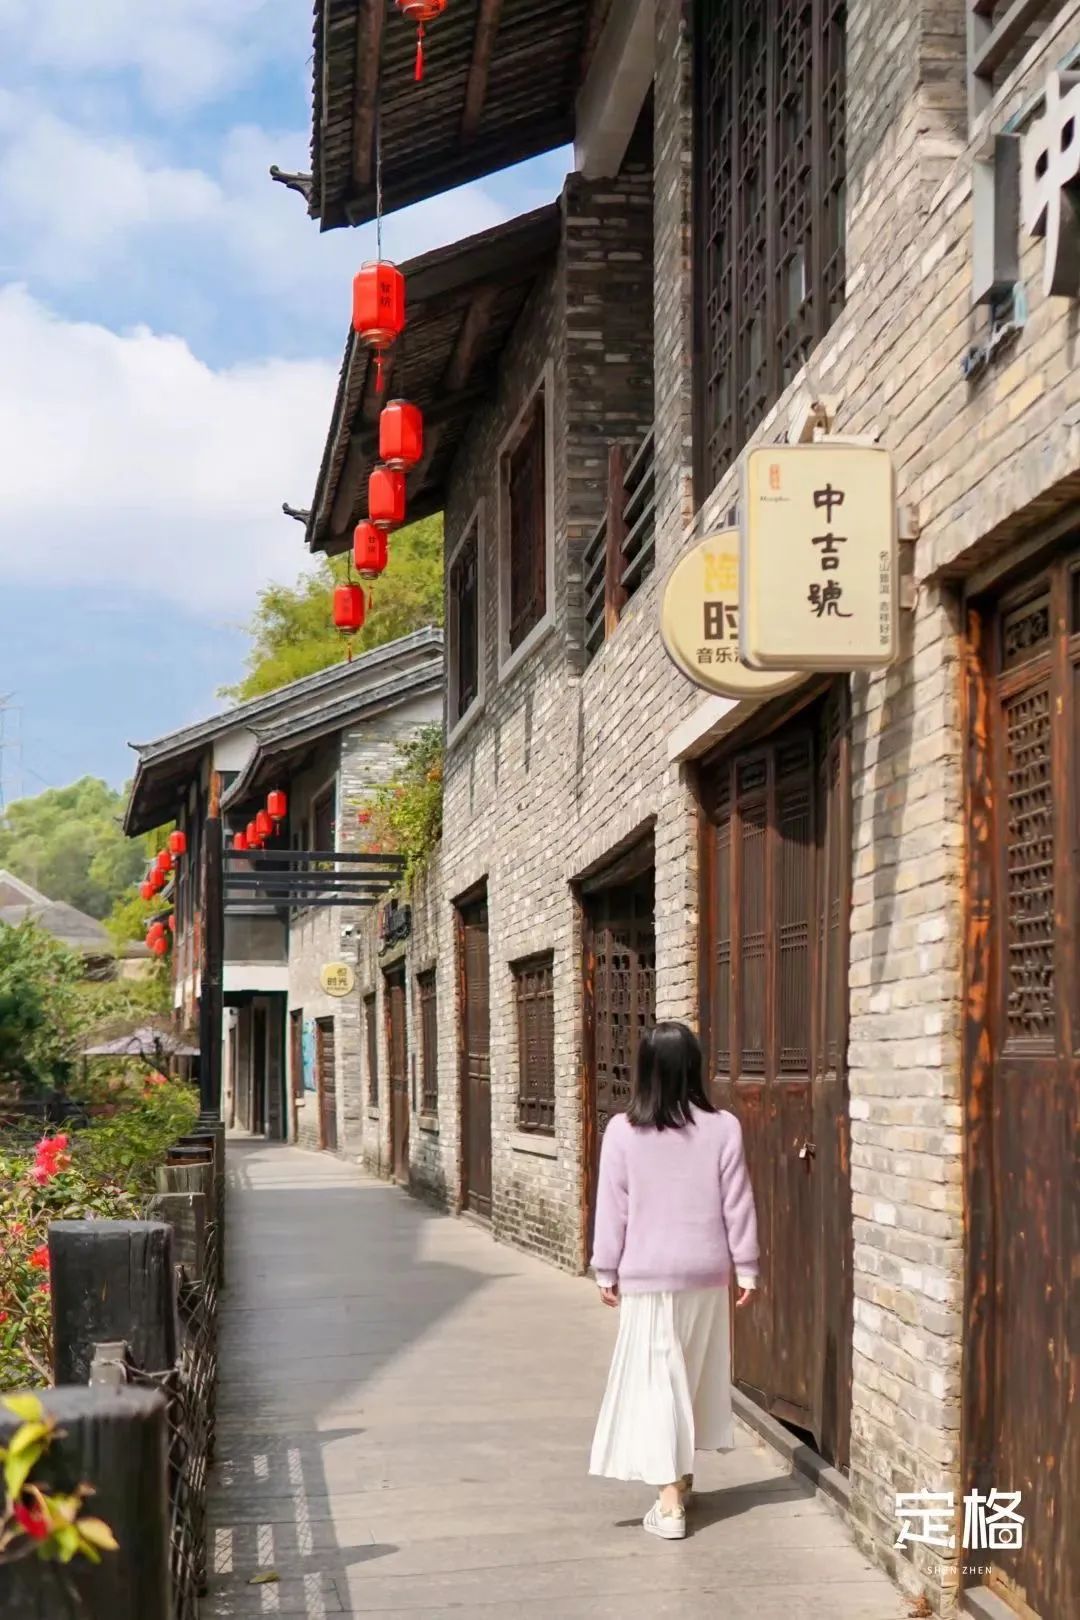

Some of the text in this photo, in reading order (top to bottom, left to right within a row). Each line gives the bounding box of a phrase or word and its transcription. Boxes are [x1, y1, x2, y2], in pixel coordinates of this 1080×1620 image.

[807, 483, 853, 617] 中吉號
[696, 647, 741, 664] 音乐
